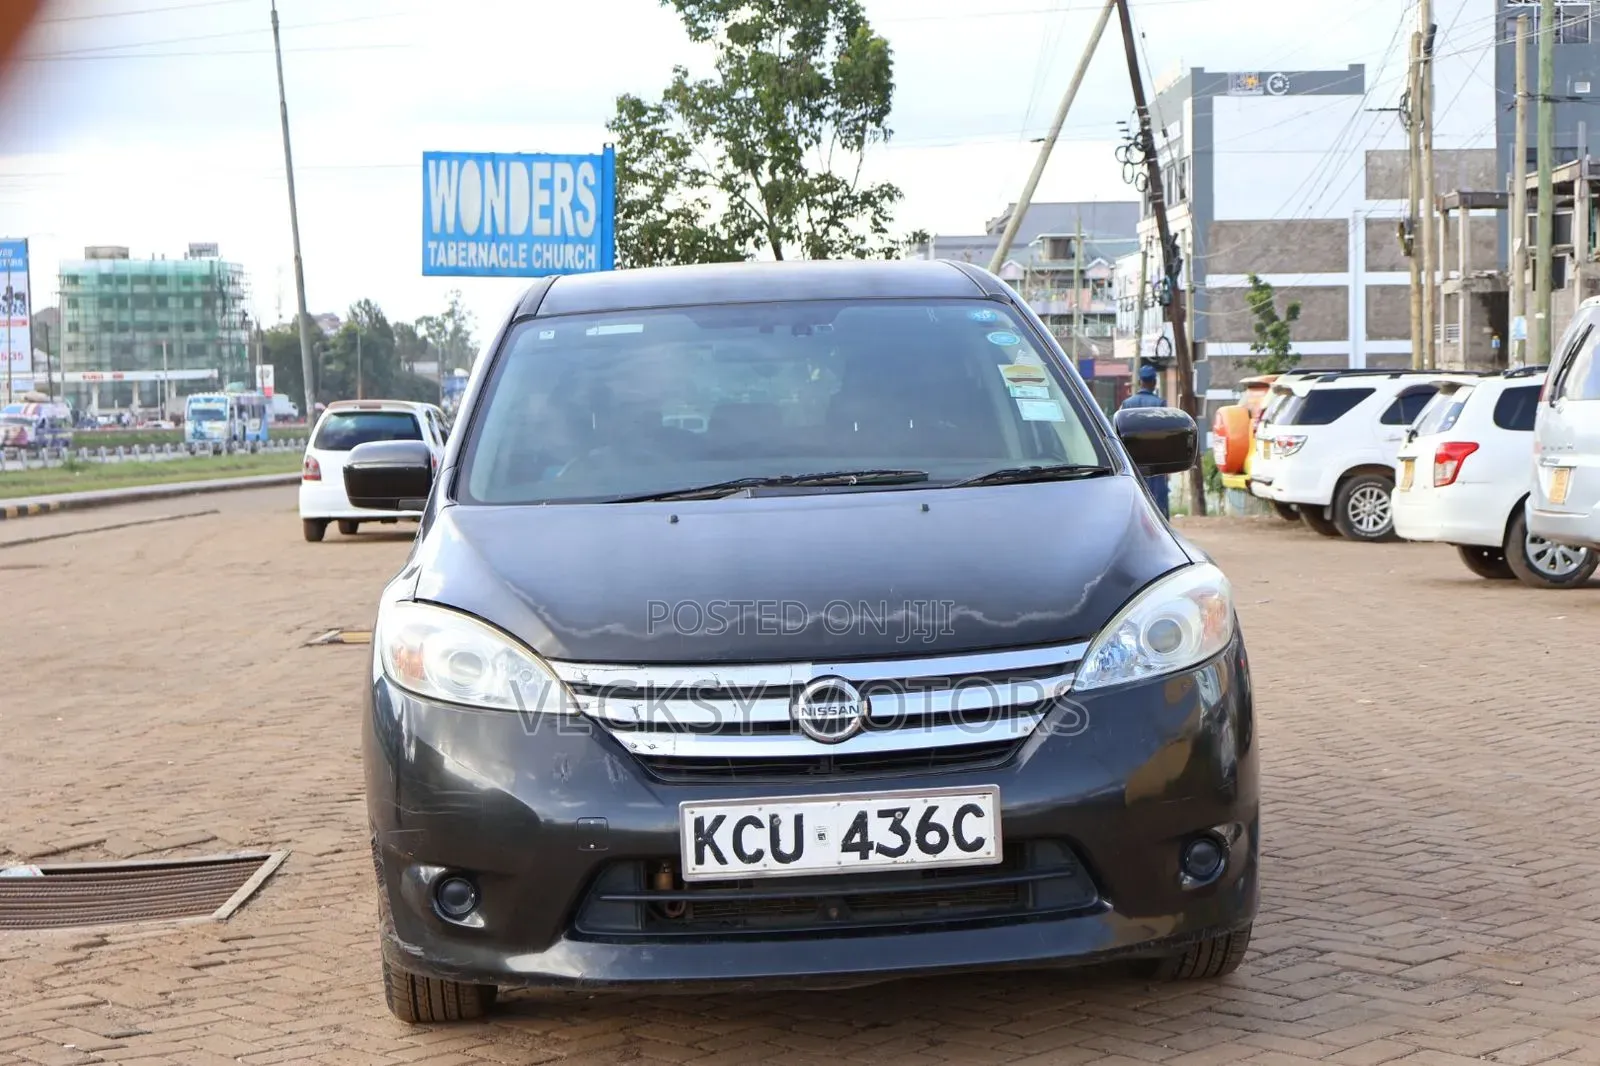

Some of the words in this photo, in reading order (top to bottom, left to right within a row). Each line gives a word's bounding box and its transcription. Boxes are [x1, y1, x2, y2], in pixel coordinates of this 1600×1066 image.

[428, 159, 597, 238] WONDERS
[428, 241, 528, 268] TABERNACLE
[532, 243, 596, 270] CHURCH
[801, 705, 860, 717] NISSAN
[694, 812, 804, 866] KCU
[840, 803, 986, 861] 436C
